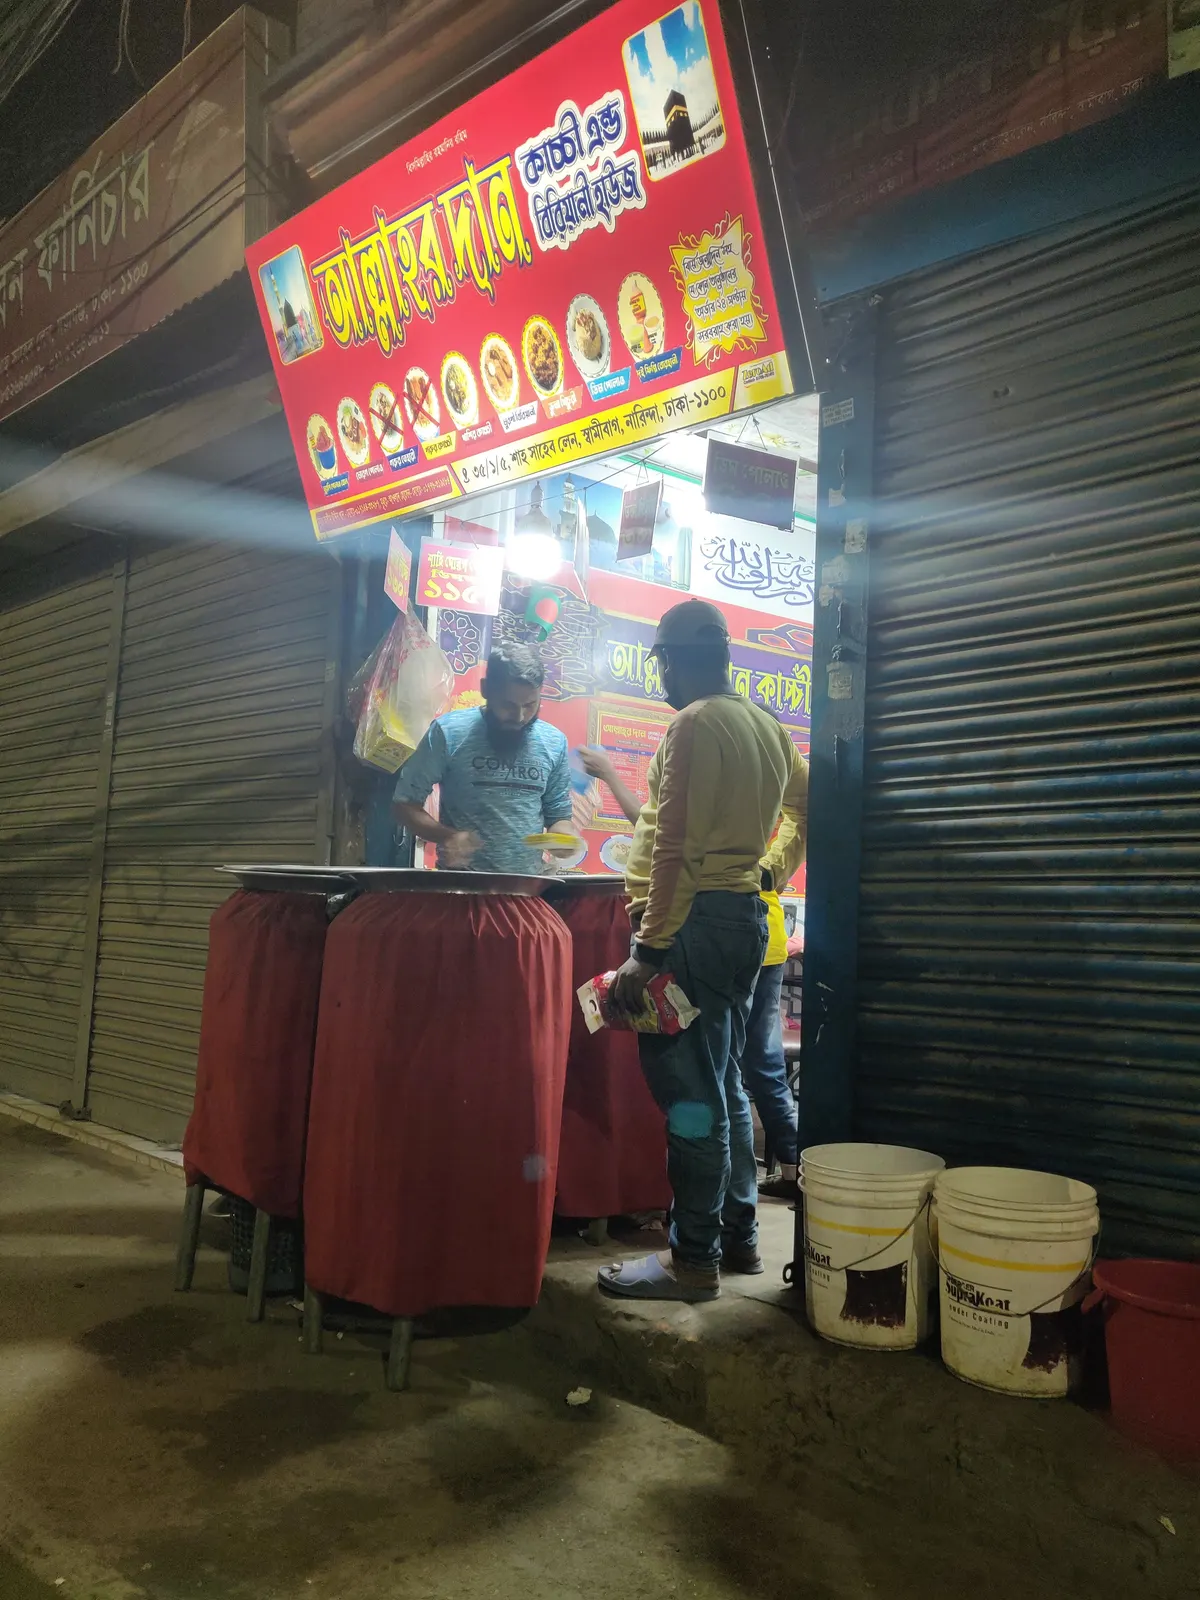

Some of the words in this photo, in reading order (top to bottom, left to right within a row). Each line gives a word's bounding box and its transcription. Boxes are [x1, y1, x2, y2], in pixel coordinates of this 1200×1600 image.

[519, 109, 585, 186] কাচ্চী
[586, 101, 622, 155] এন্ড
[34, 142, 155, 293] ফার্নিচার
[532, 170, 596, 243] বিরিয়ানী
[590, 158, 641, 226] হাউজ
[120, 262, 149, 295] ১১০০
[311, 207, 453, 355] আল্লাহর
[437, 155, 533, 303] দান
[529, 437, 557, 461] সাহেব
[557, 432, 583, 454] লেন,
[581, 415, 625, 446] স্বামীবাগ,
[624, 401, 664, 431] নারিন্দা,
[665, 384, 727, 418] ঢাকা-১১০০
[588, 380, 604, 397] ডিম
[603, 374, 627, 391] পোলাও
[972, 1312, 1009, 1330] Coating
